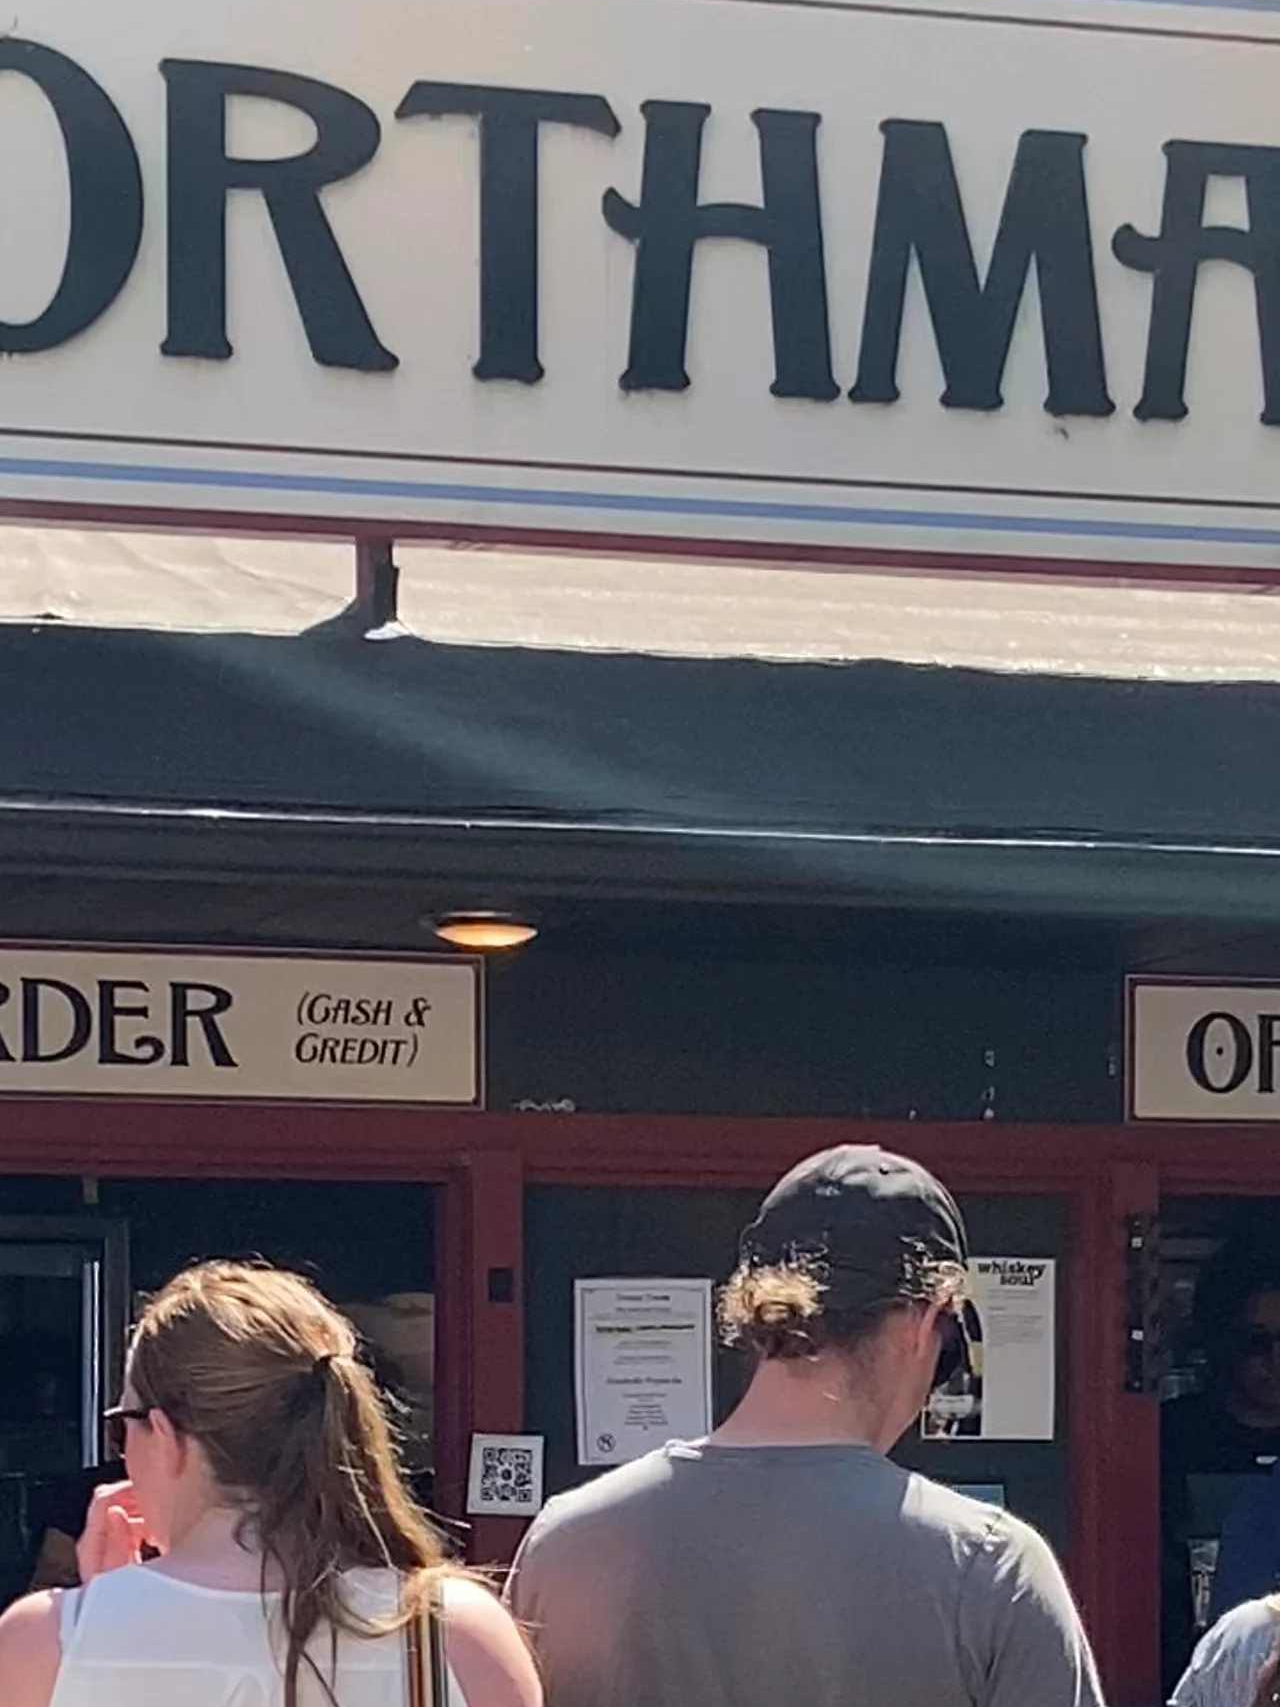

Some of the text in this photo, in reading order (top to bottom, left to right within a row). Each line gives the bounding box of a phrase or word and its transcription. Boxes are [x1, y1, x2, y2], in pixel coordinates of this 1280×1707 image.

[297, 991, 393, 1026] (CASH
[403, 996, 432, 1028] &
[295, 1032, 419, 1067] CREDIT)
[977, 1260, 1047, 1280] whiskey
